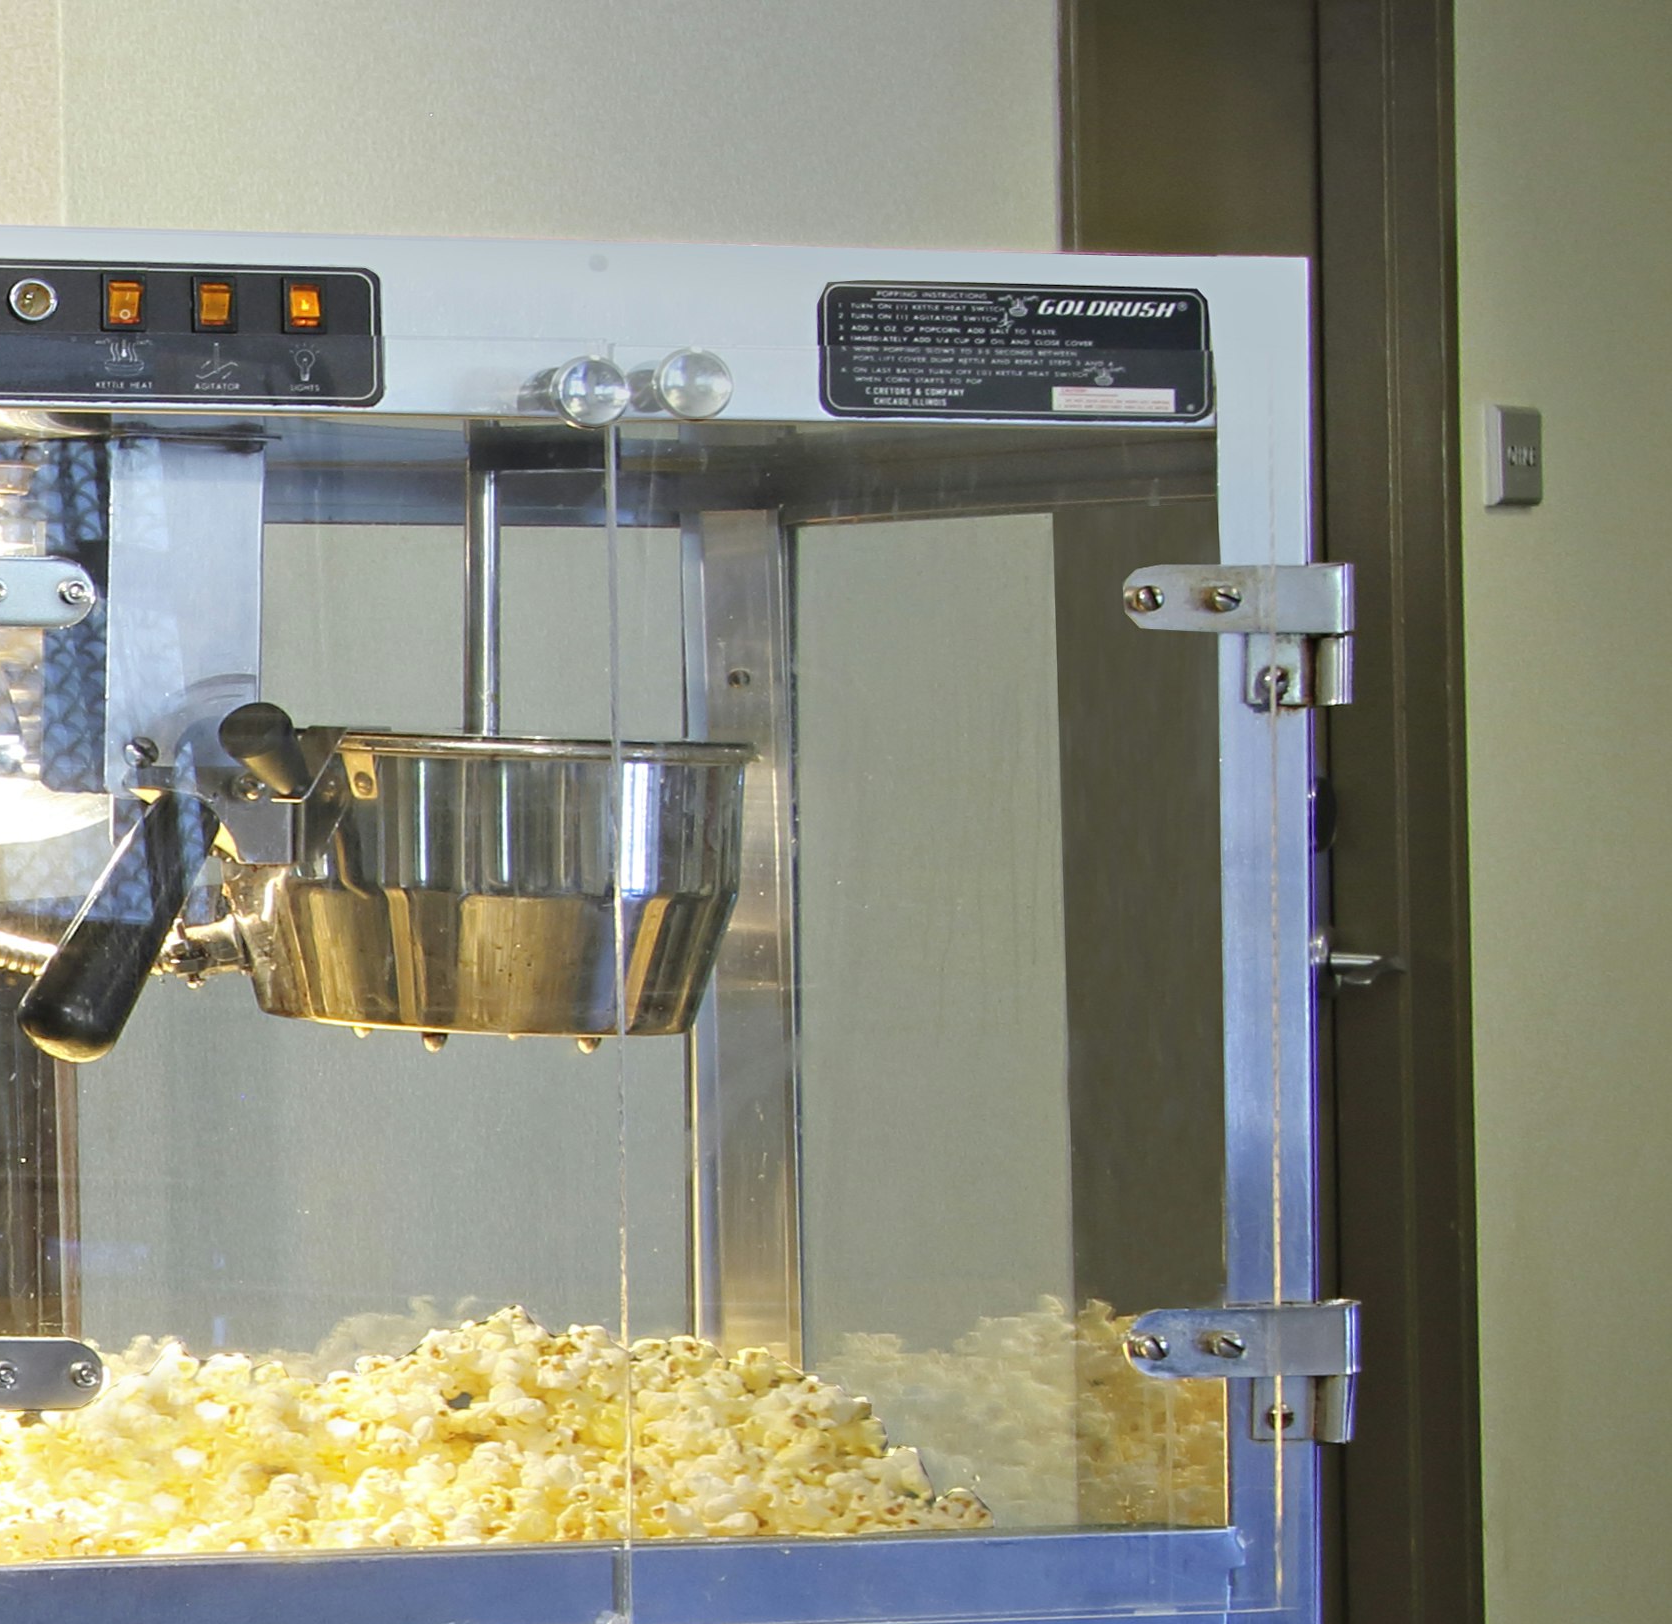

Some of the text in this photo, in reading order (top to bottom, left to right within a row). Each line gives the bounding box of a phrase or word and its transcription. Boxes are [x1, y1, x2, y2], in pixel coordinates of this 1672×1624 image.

[876, 290, 918, 298] POPPING
[921, 291, 988, 300] INSTRUCTIONS
[971, 305, 1006, 313] SWITCH
[913, 314, 958, 322] AGITATOR
[963, 315, 998, 323] SWITCH
[989, 328, 1009, 336] SALT
[850, 335, 908, 343] IMMEDIATELY
[913, 336, 931, 344] ADD
[990, 338, 1006, 346] OIL
[1064, 340, 1094, 348] COVER
[883, 346, 921, 354] POPPING
[925, 347, 955, 355] SLOWS
[994, 348, 1034, 356] SECONDS
[930, 356, 955, 364] DUMP
[958, 357, 985, 365] KETTLE
[1014, 358, 1044, 366] REPEAT
[1048, 359, 1072, 367] STEPS
[1084, 360, 1104, 368] AND
[852, 366, 868, 374] ON
[895, 367, 925, 375] BATCH
[995, 369, 1024, 377] KETTLE
[885, 376, 911, 384] CORN
[915, 377, 945, 385] STARTS
[95, 381, 153, 390] KETTLE HEAT
[194, 382, 241, 391] AGITATOR
[290, 384, 321, 392] LIGHTS
[915, 387, 922, 396] &
[924, 388, 965, 397] COMPANY
